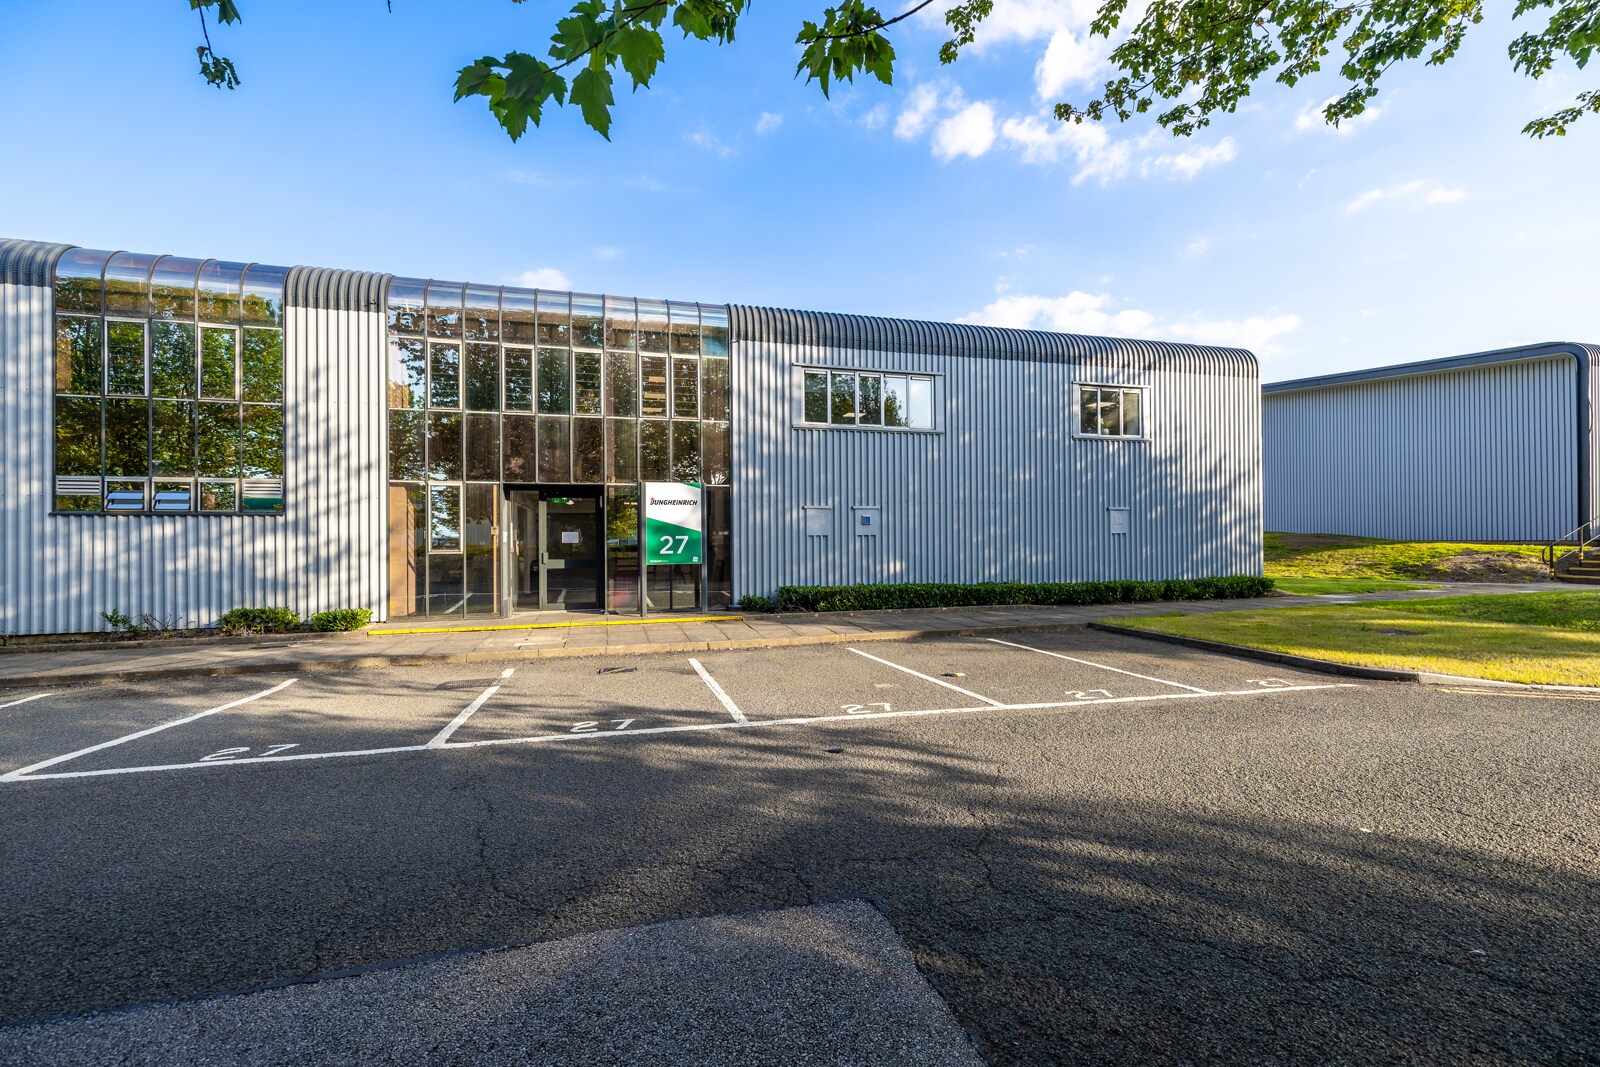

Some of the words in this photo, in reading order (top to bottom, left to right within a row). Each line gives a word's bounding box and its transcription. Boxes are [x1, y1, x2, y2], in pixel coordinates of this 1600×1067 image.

[650, 497, 698, 506] JUNGHEINRICH
[659, 535, 689, 555] 27
[1064, 689, 1113, 699] 27
[840, 702, 892, 715] 27
[569, 718, 636, 733] 27
[199, 743, 300, 761] 27
